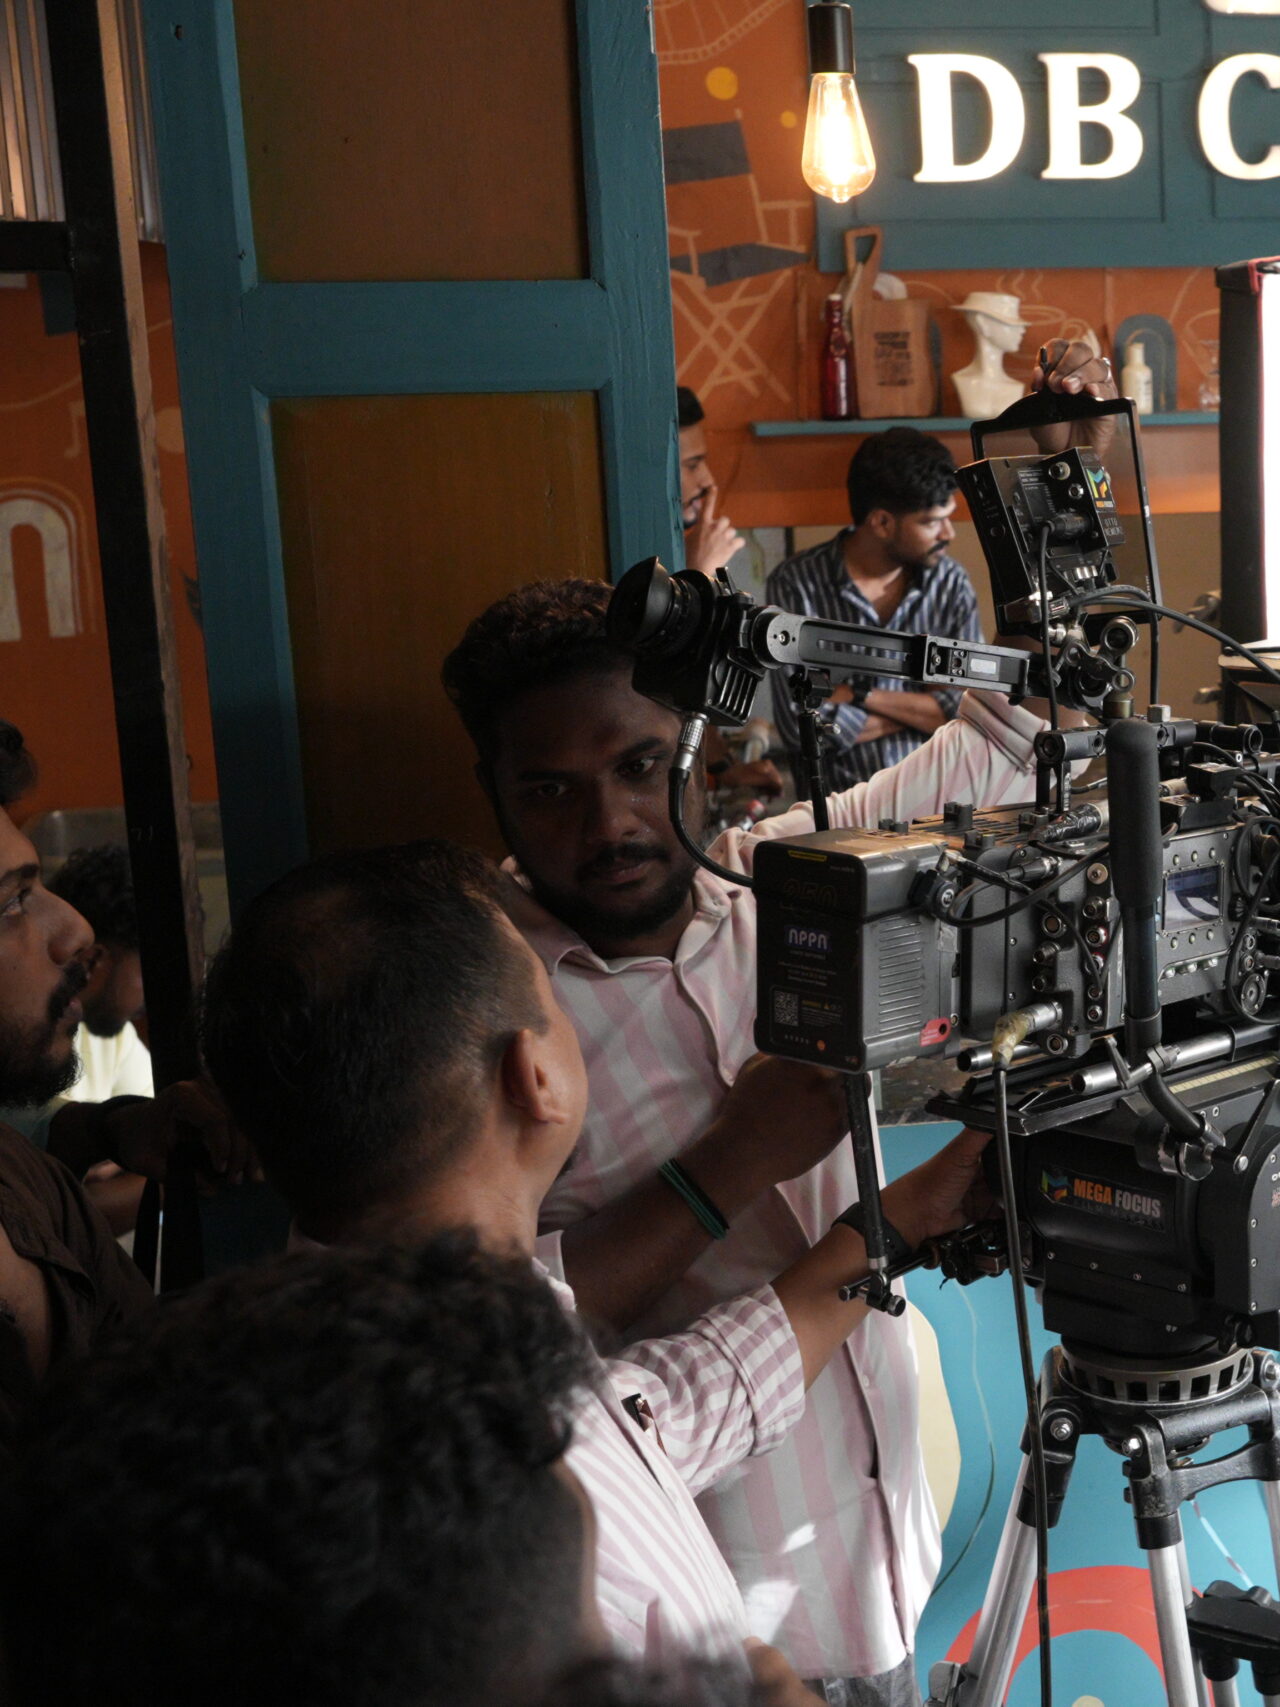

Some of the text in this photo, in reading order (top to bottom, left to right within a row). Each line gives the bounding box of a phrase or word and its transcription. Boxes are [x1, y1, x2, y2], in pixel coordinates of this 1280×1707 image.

[906, 52, 1144, 183] DB
[1073, 1177, 1161, 1218] MEGA FOCUS
